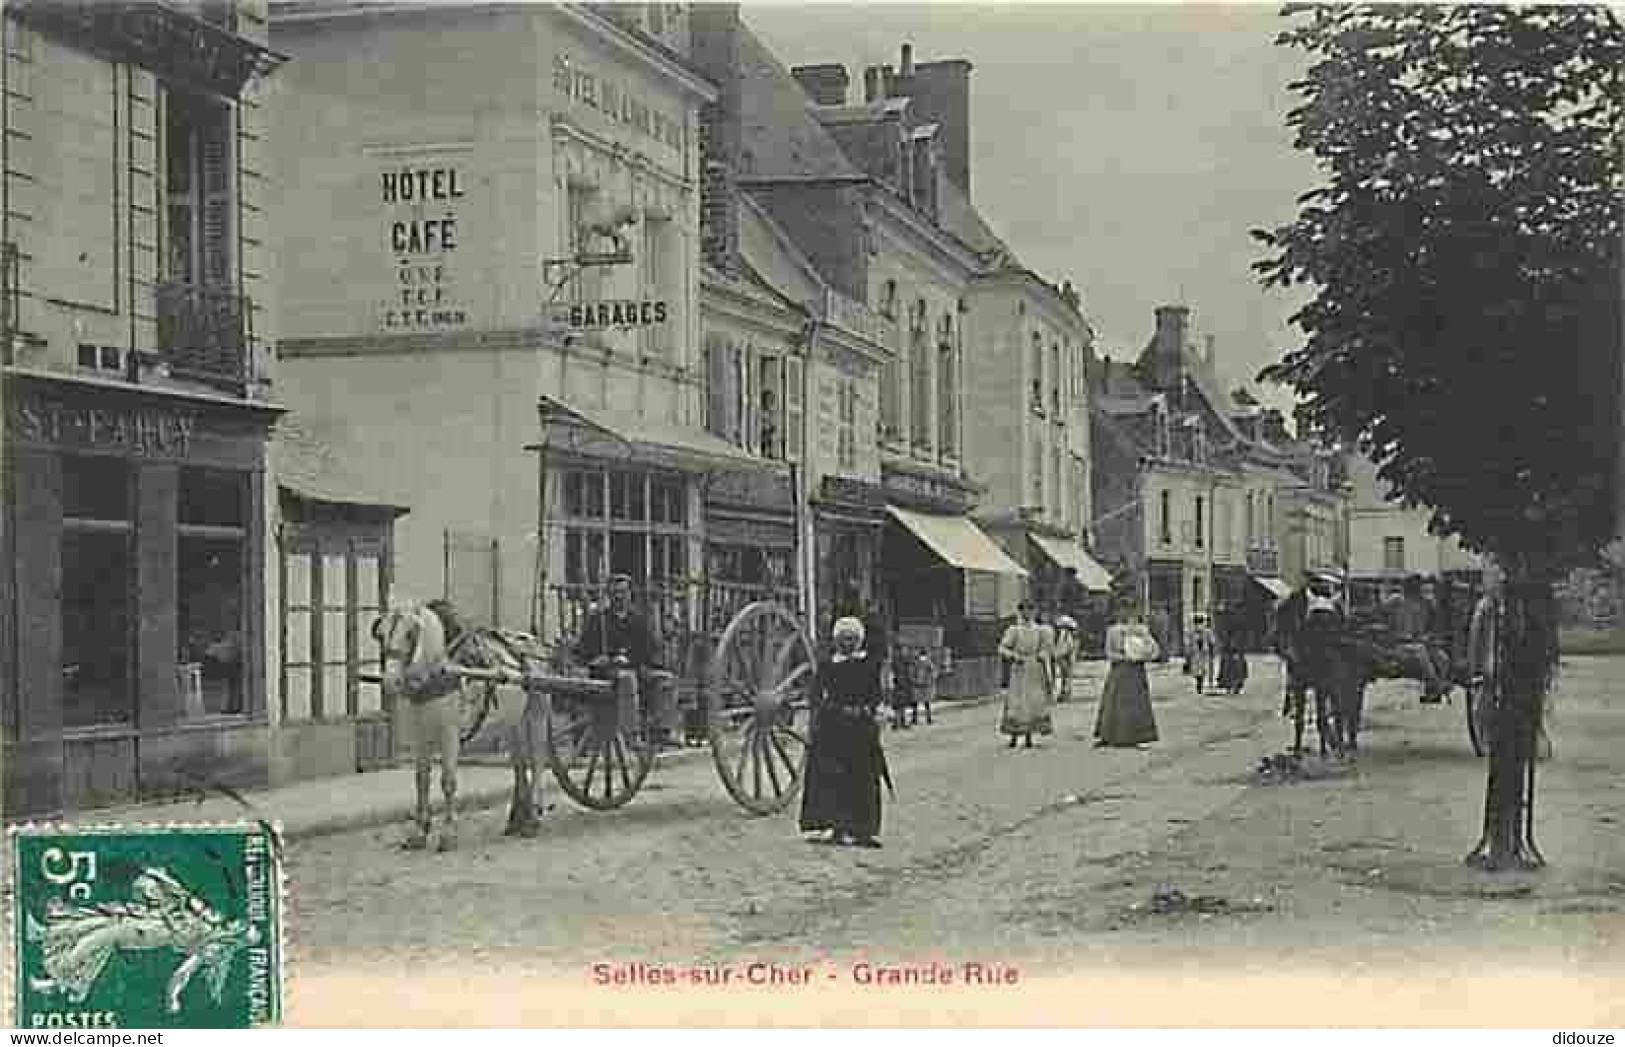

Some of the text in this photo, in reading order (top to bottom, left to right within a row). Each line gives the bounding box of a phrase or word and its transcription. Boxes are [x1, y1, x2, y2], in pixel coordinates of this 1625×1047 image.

[382, 166, 464, 202] HÔTEL
[392, 210, 456, 253] CAFÉ
[570, 301, 666, 327] GARAGES
